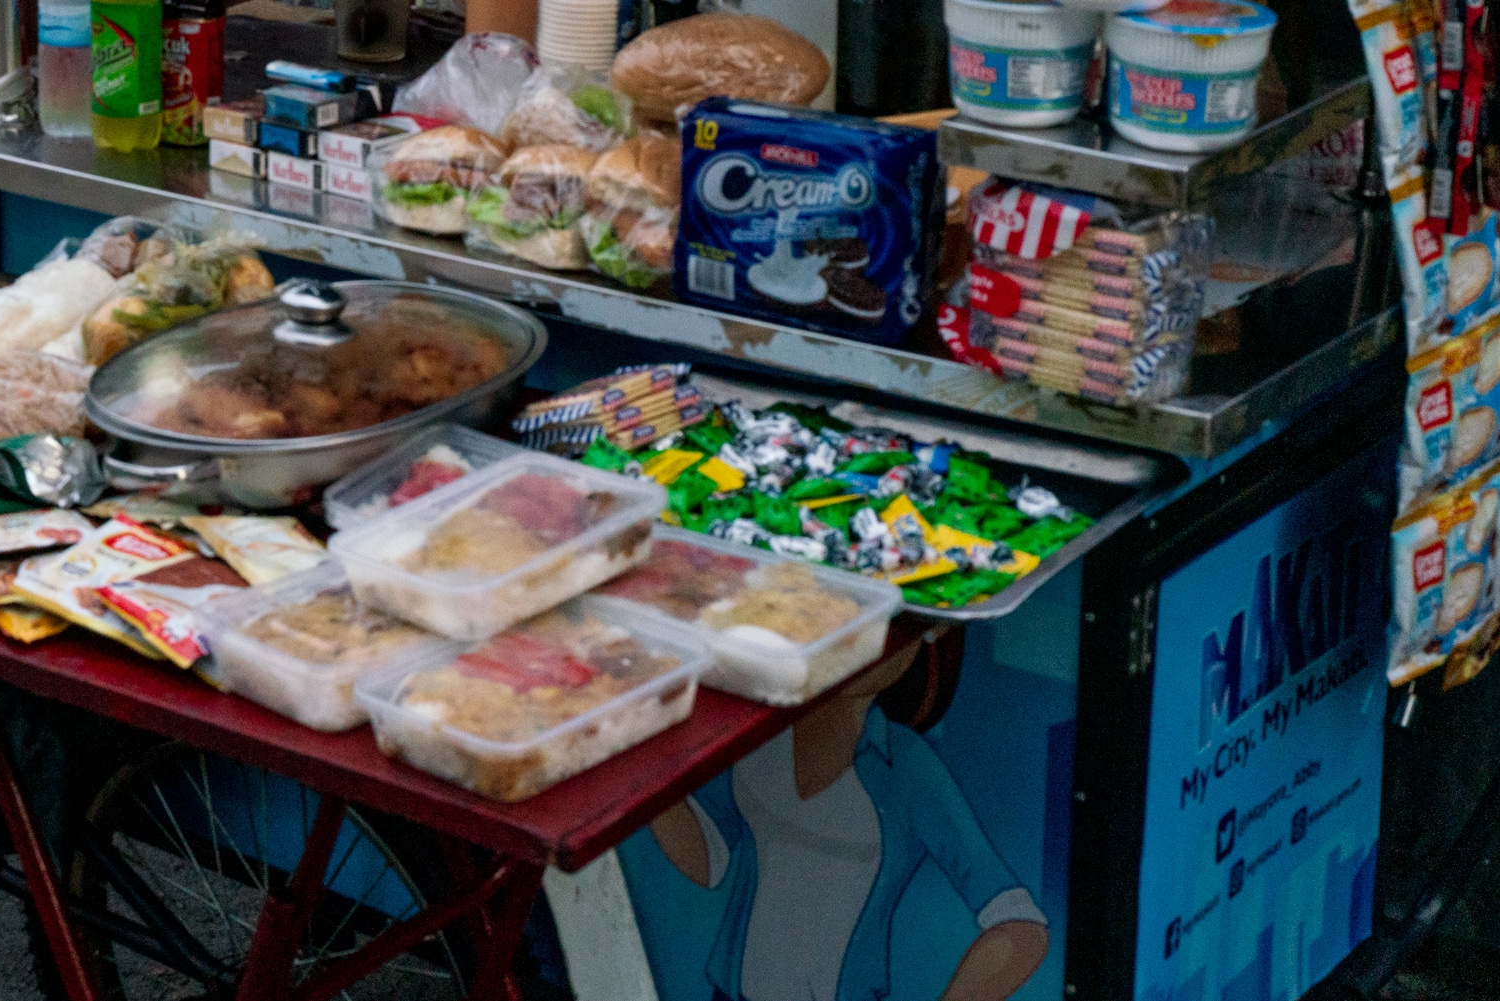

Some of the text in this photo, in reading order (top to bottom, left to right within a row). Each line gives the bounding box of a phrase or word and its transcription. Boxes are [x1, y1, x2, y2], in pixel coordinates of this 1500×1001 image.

[695, 119, 718, 142] 10
[1180, 766, 1211, 809] My
[1263, 699, 1293, 742] My
